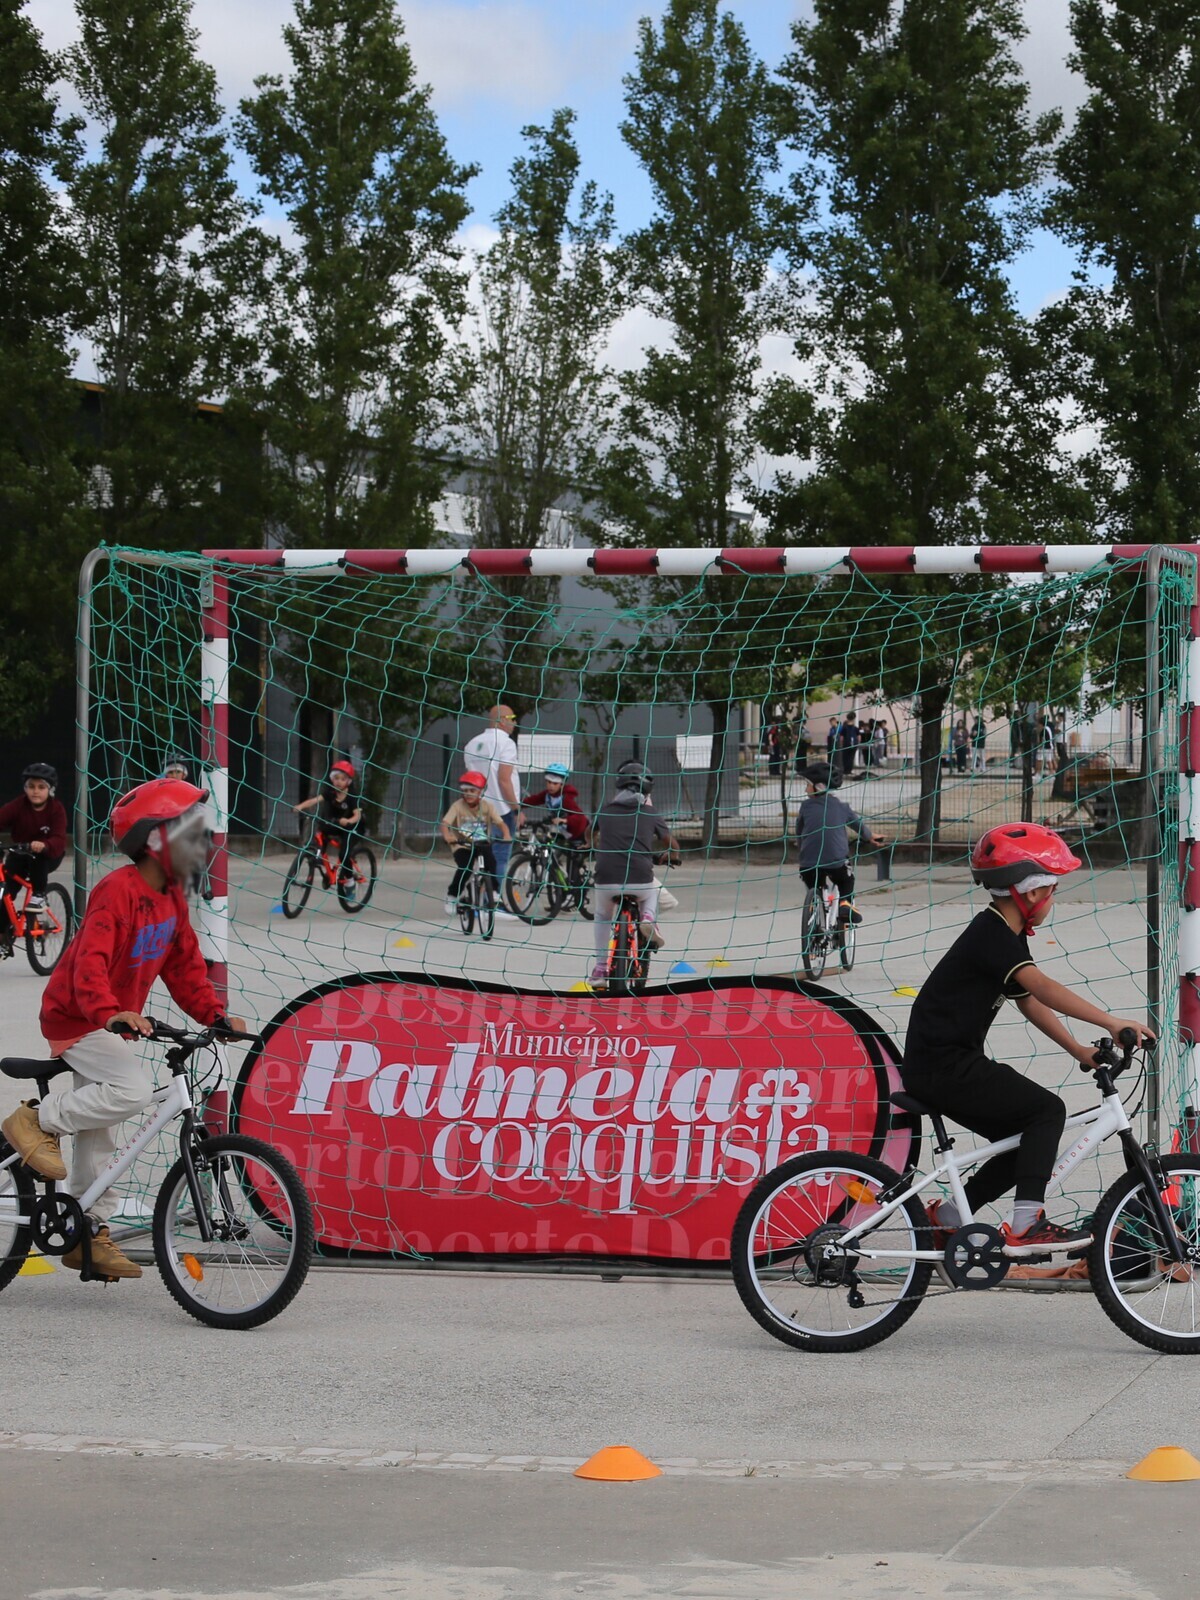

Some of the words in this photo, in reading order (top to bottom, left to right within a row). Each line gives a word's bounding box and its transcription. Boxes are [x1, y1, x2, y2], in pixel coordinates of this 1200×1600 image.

[479, 1021, 643, 1068] Município
[288, 1039, 744, 1122] Palmela
[108, 1111, 158, 1170] ROCKRIDER
